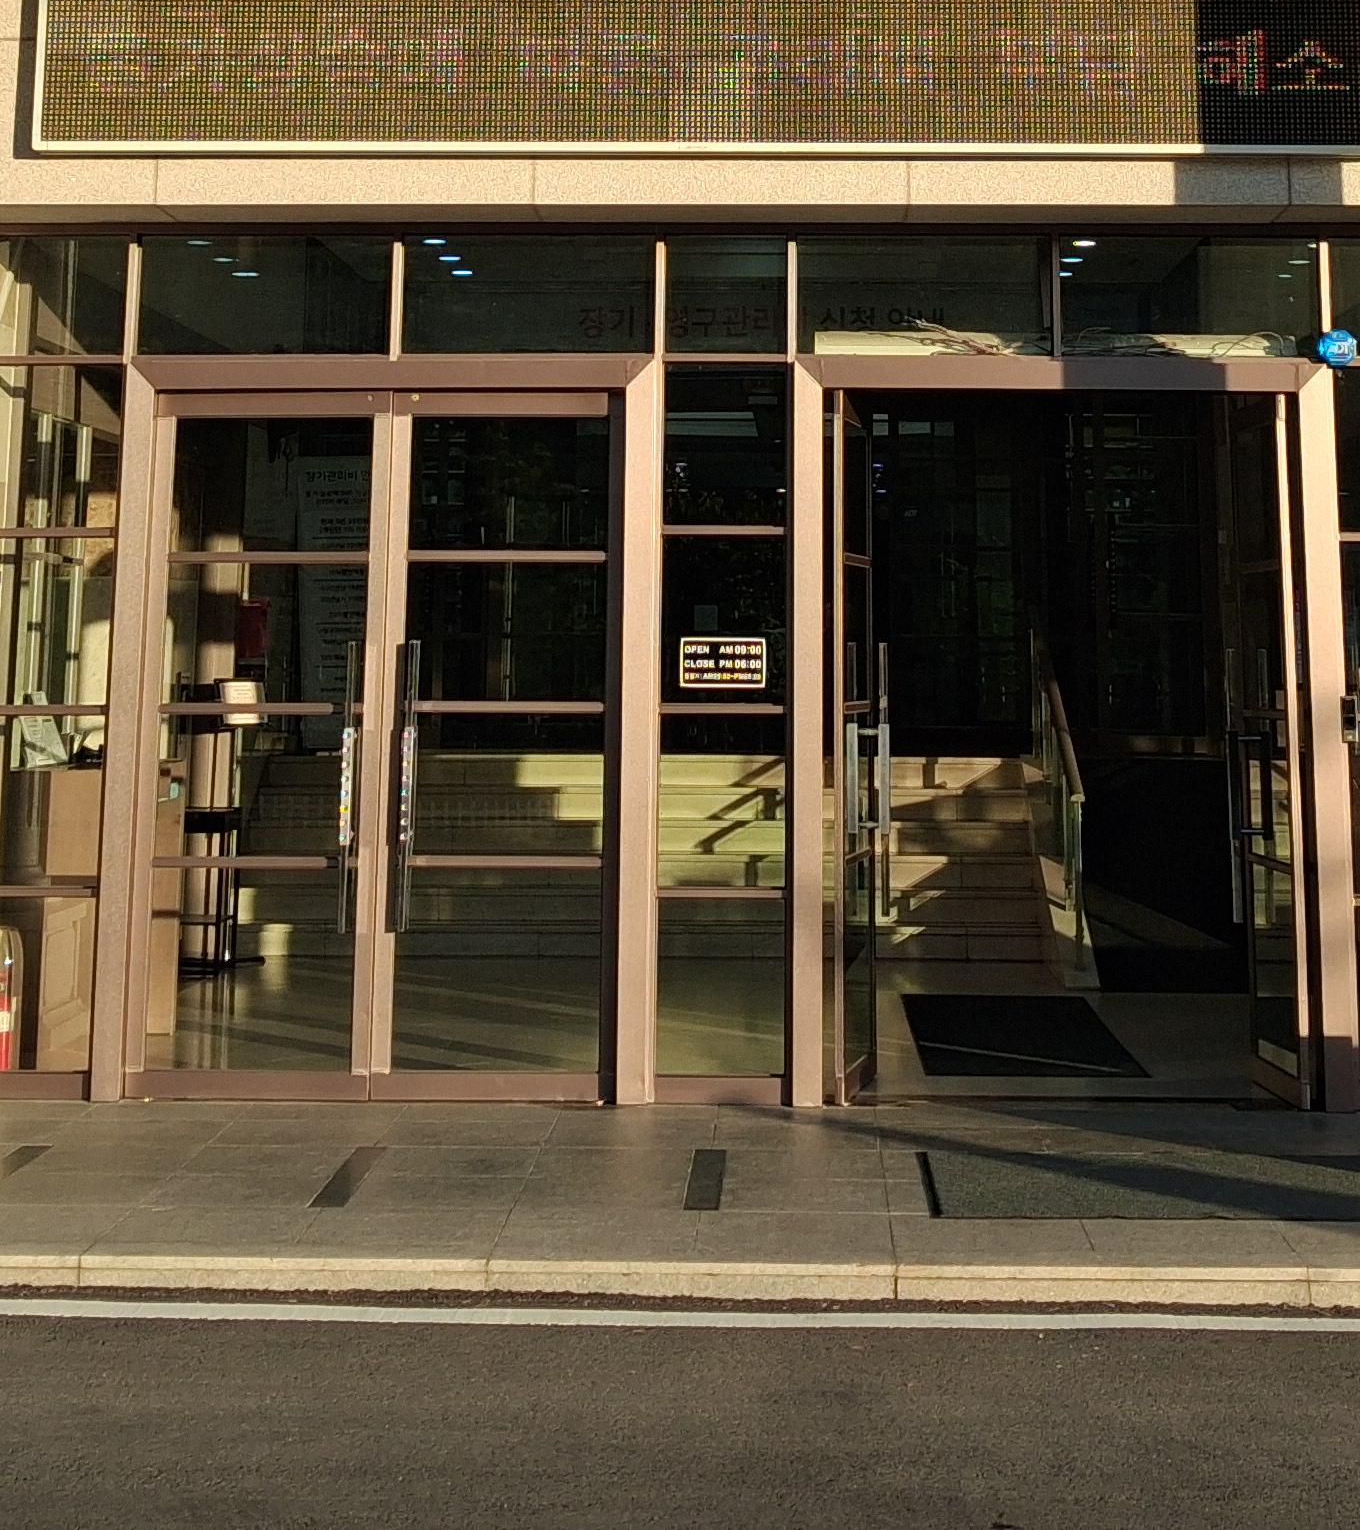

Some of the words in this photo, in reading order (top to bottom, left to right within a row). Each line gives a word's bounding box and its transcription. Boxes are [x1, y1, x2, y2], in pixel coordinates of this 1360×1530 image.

[1193, 28, 1351, 95] 해소
[684, 645, 710, 654] OPEN
[719, 645, 733, 654] AM
[684, 659, 715, 668] CLOSE
[719, 659, 733, 668] PM
